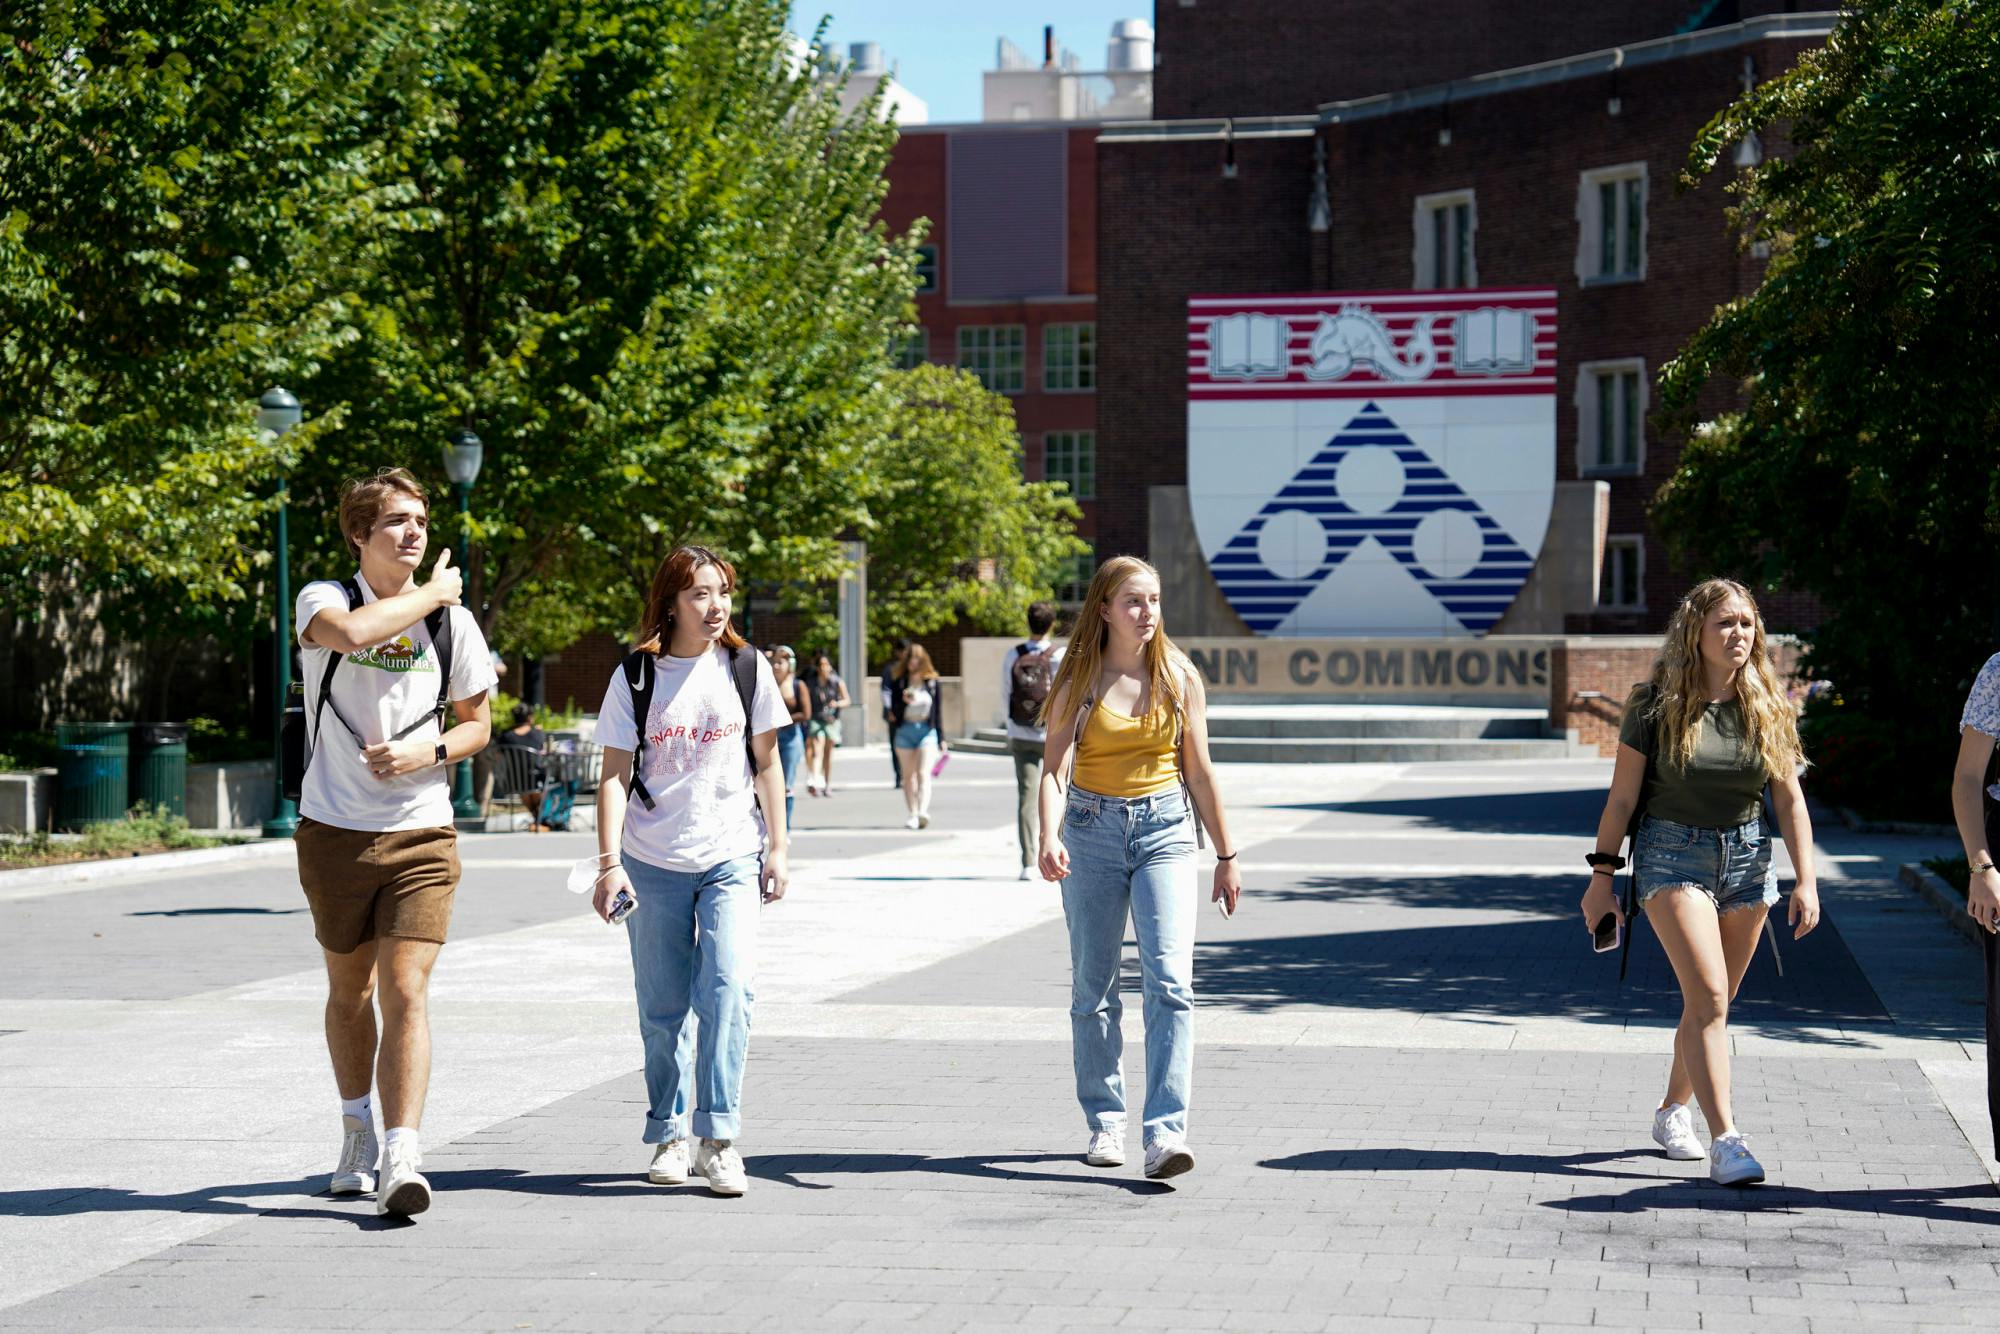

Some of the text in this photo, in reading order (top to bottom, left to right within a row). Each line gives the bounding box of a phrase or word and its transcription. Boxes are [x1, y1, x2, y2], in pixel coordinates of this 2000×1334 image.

[369, 648, 430, 669] Columbia
[1189, 648, 1258, 686] NN
[688, 728, 698, 741] &
[701, 721, 742, 743] DSGN
